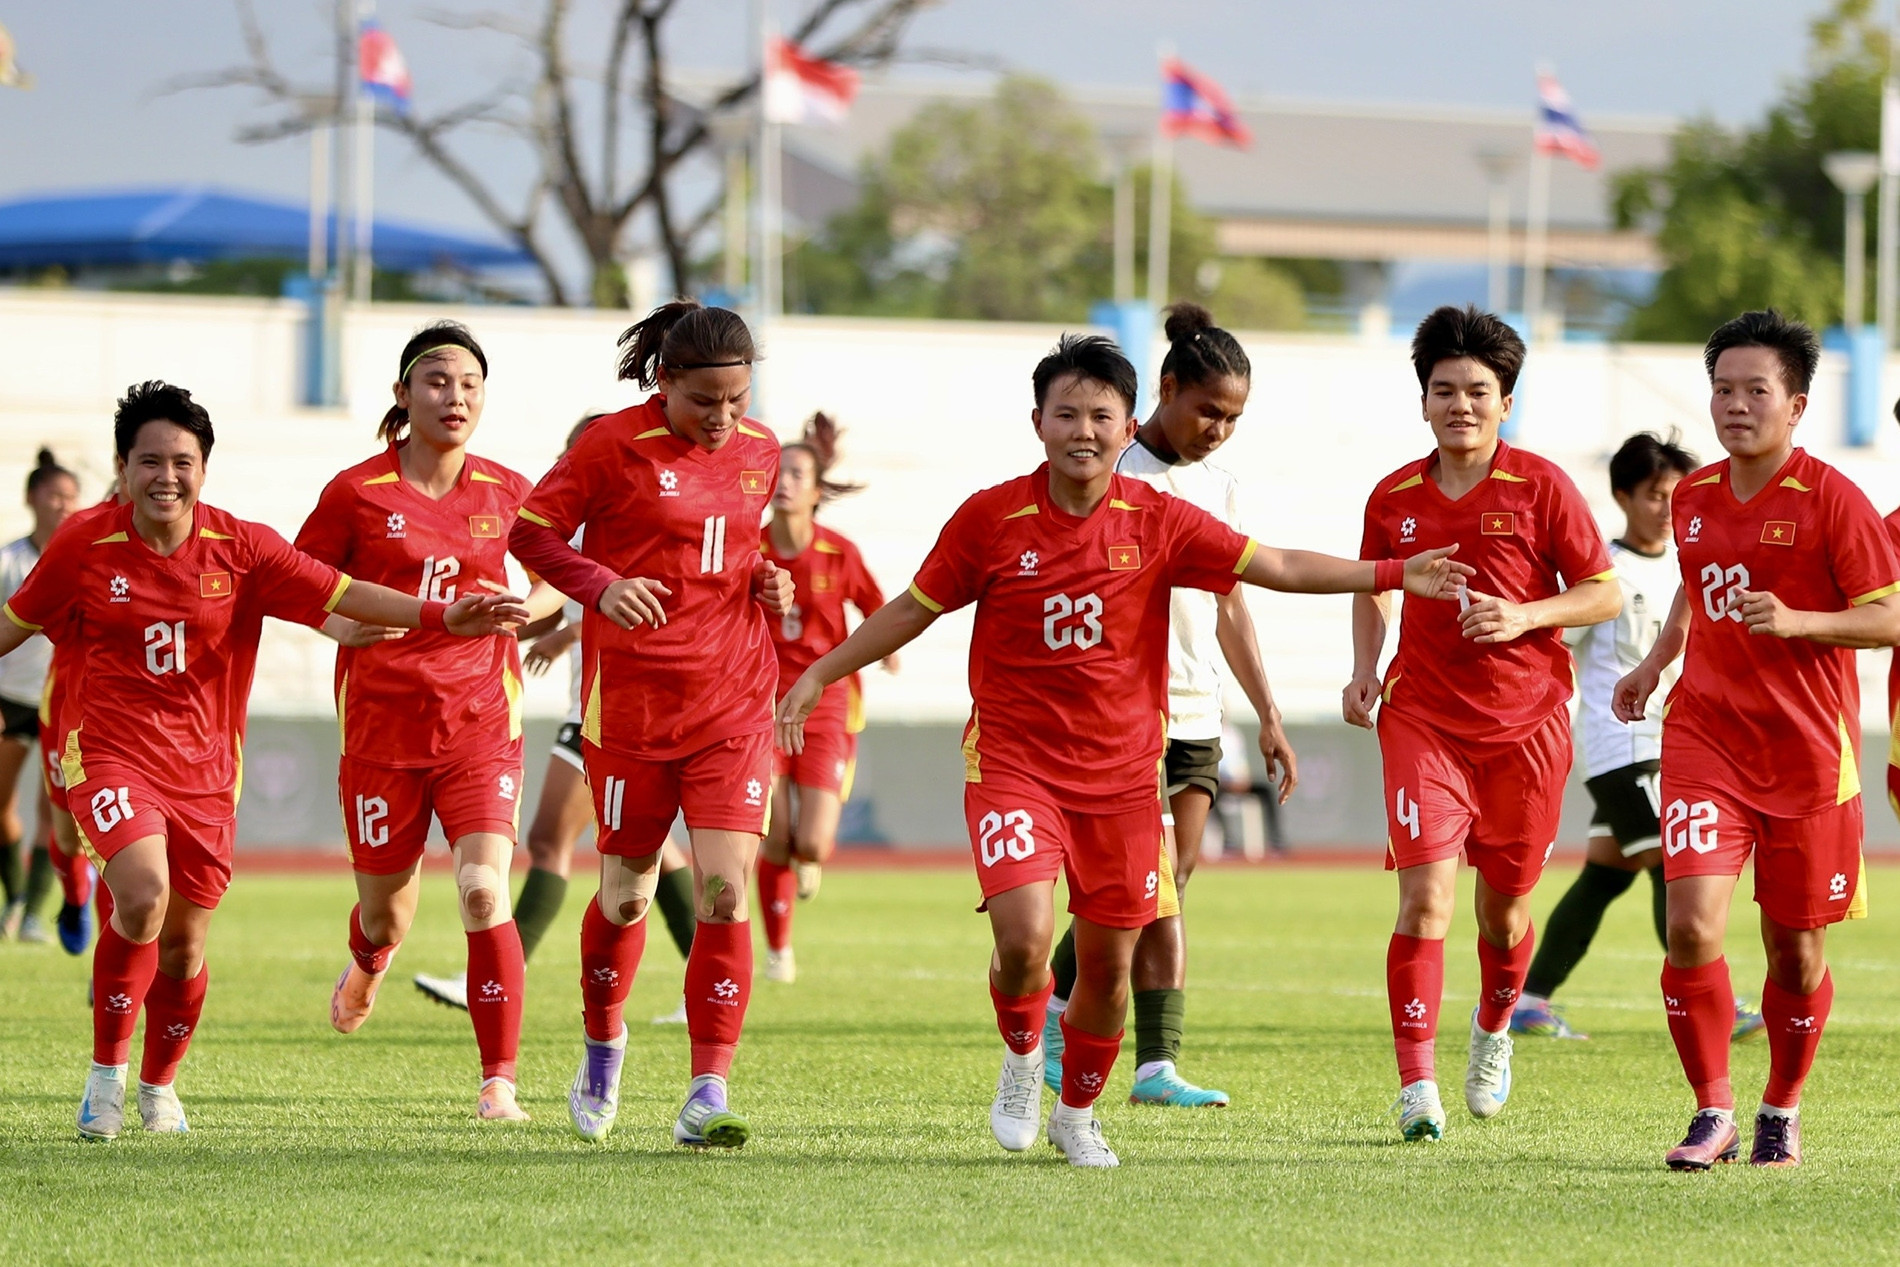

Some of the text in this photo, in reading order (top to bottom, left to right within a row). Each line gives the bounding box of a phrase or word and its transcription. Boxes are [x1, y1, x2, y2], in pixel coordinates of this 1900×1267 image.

[701, 514, 726, 575] 11
[417, 554, 460, 604] 12
[144, 620, 186, 676] 21
[1044, 592, 1103, 651] 23
[91, 787, 134, 832] 21
[356, 794, 389, 847] 12
[604, 775, 626, 830] 11
[1396, 786, 1420, 840] 4
[1665, 798, 1719, 858] 22
[979, 809, 1036, 868] 23
